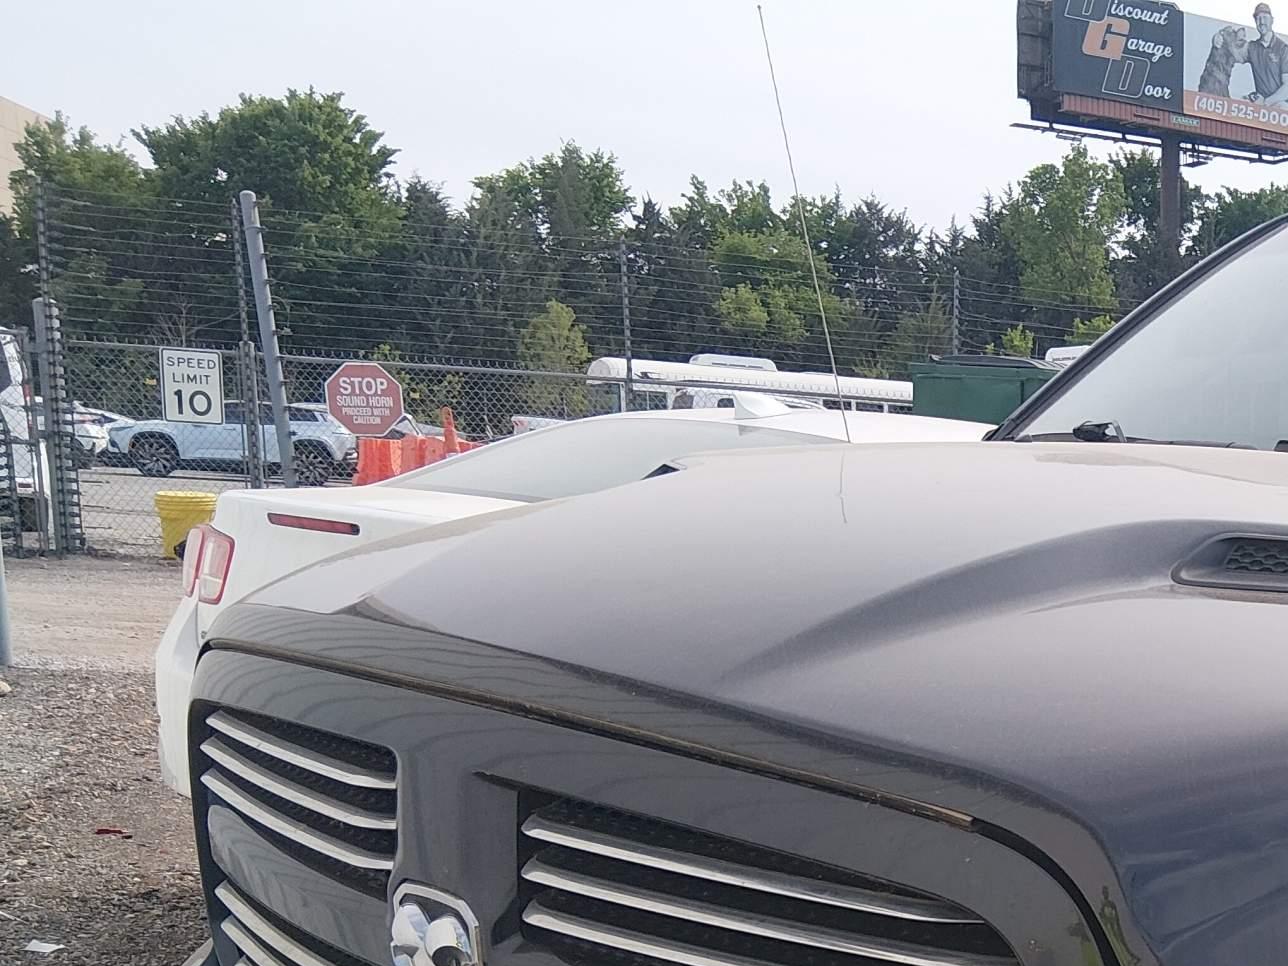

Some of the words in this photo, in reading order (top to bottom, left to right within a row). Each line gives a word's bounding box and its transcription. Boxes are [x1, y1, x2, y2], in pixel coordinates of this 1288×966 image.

[1082, 16, 1174, 62] Garage
[1101, 53, 1172, 99] Door
[1194, 95, 1228, 116] (405)
[166, 356, 216, 370] SPEED
[172, 372, 211, 385] LIMIT
[339, 376, 388, 395] STOP
[173, 388, 212, 417] 10
[336, 395, 367, 407] SOUND
[368, 396, 394, 408] HORN
[342, 407, 372, 416] PROCEED
[372, 408, 391, 416] WITH
[353, 416, 381, 424] CAUTION
